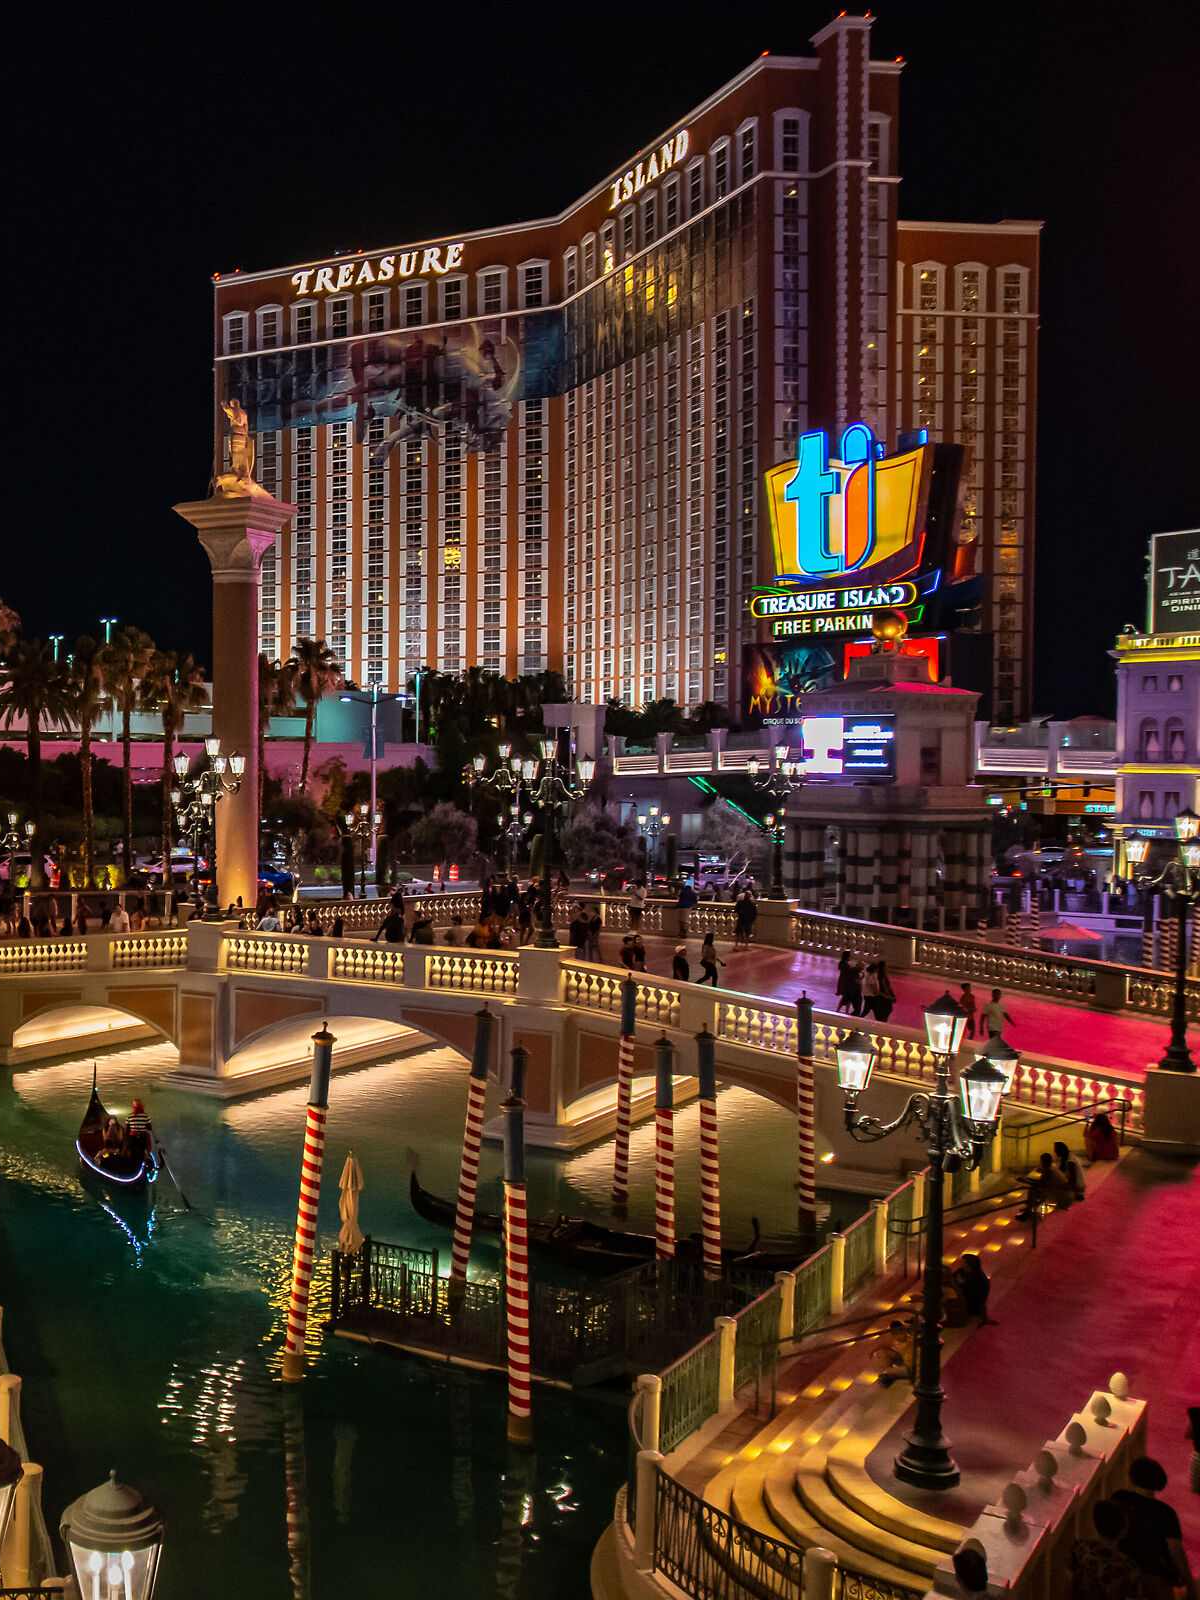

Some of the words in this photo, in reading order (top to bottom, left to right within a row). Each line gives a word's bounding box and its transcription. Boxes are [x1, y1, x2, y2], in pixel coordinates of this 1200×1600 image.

[291, 243, 465, 295] TREASURE
[608, 129, 690, 211] ISLAND
[760, 592, 836, 614] TREASURE
[843, 585, 905, 608] ISLAND
[1171, 604, 1200, 612] DINI
[773, 619, 812, 636] FREE
[814, 614, 873, 633] PARKIN
